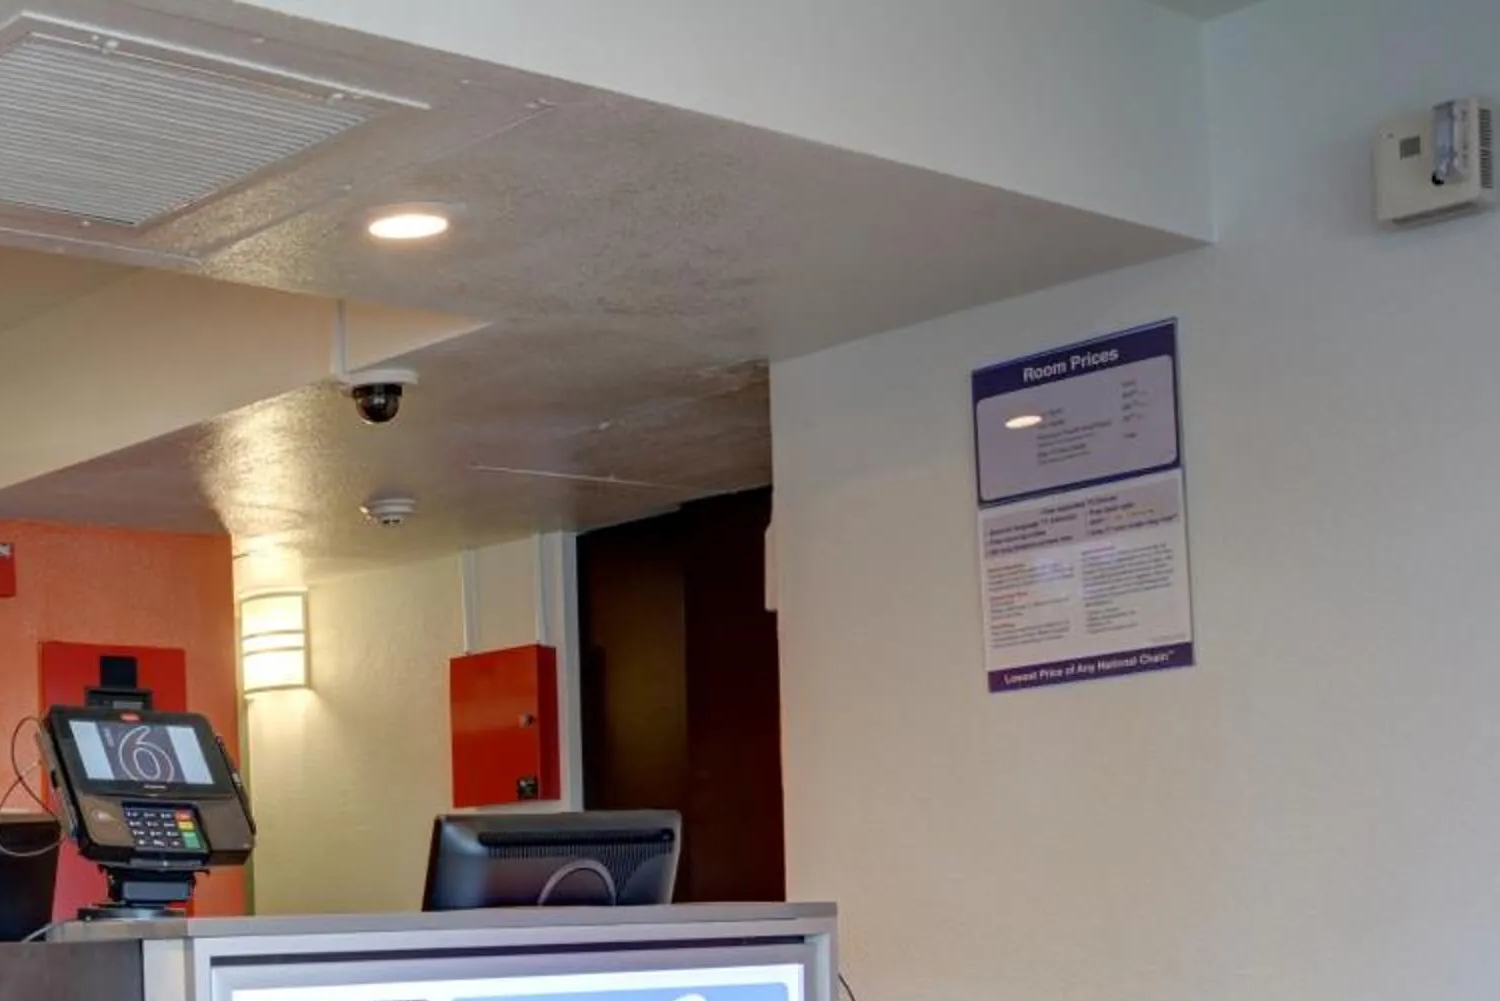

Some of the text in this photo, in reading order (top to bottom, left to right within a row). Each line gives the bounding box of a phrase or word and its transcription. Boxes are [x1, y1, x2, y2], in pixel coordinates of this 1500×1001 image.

[1023, 349, 1119, 383] Room Prices
[1003, 671, 1038, 685] Lowest
[1039, 668, 1063, 680] Price
[1076, 663, 1095, 675] Any
[1097, 655, 1137, 672] National
[118, 724, 176, 784] 6
